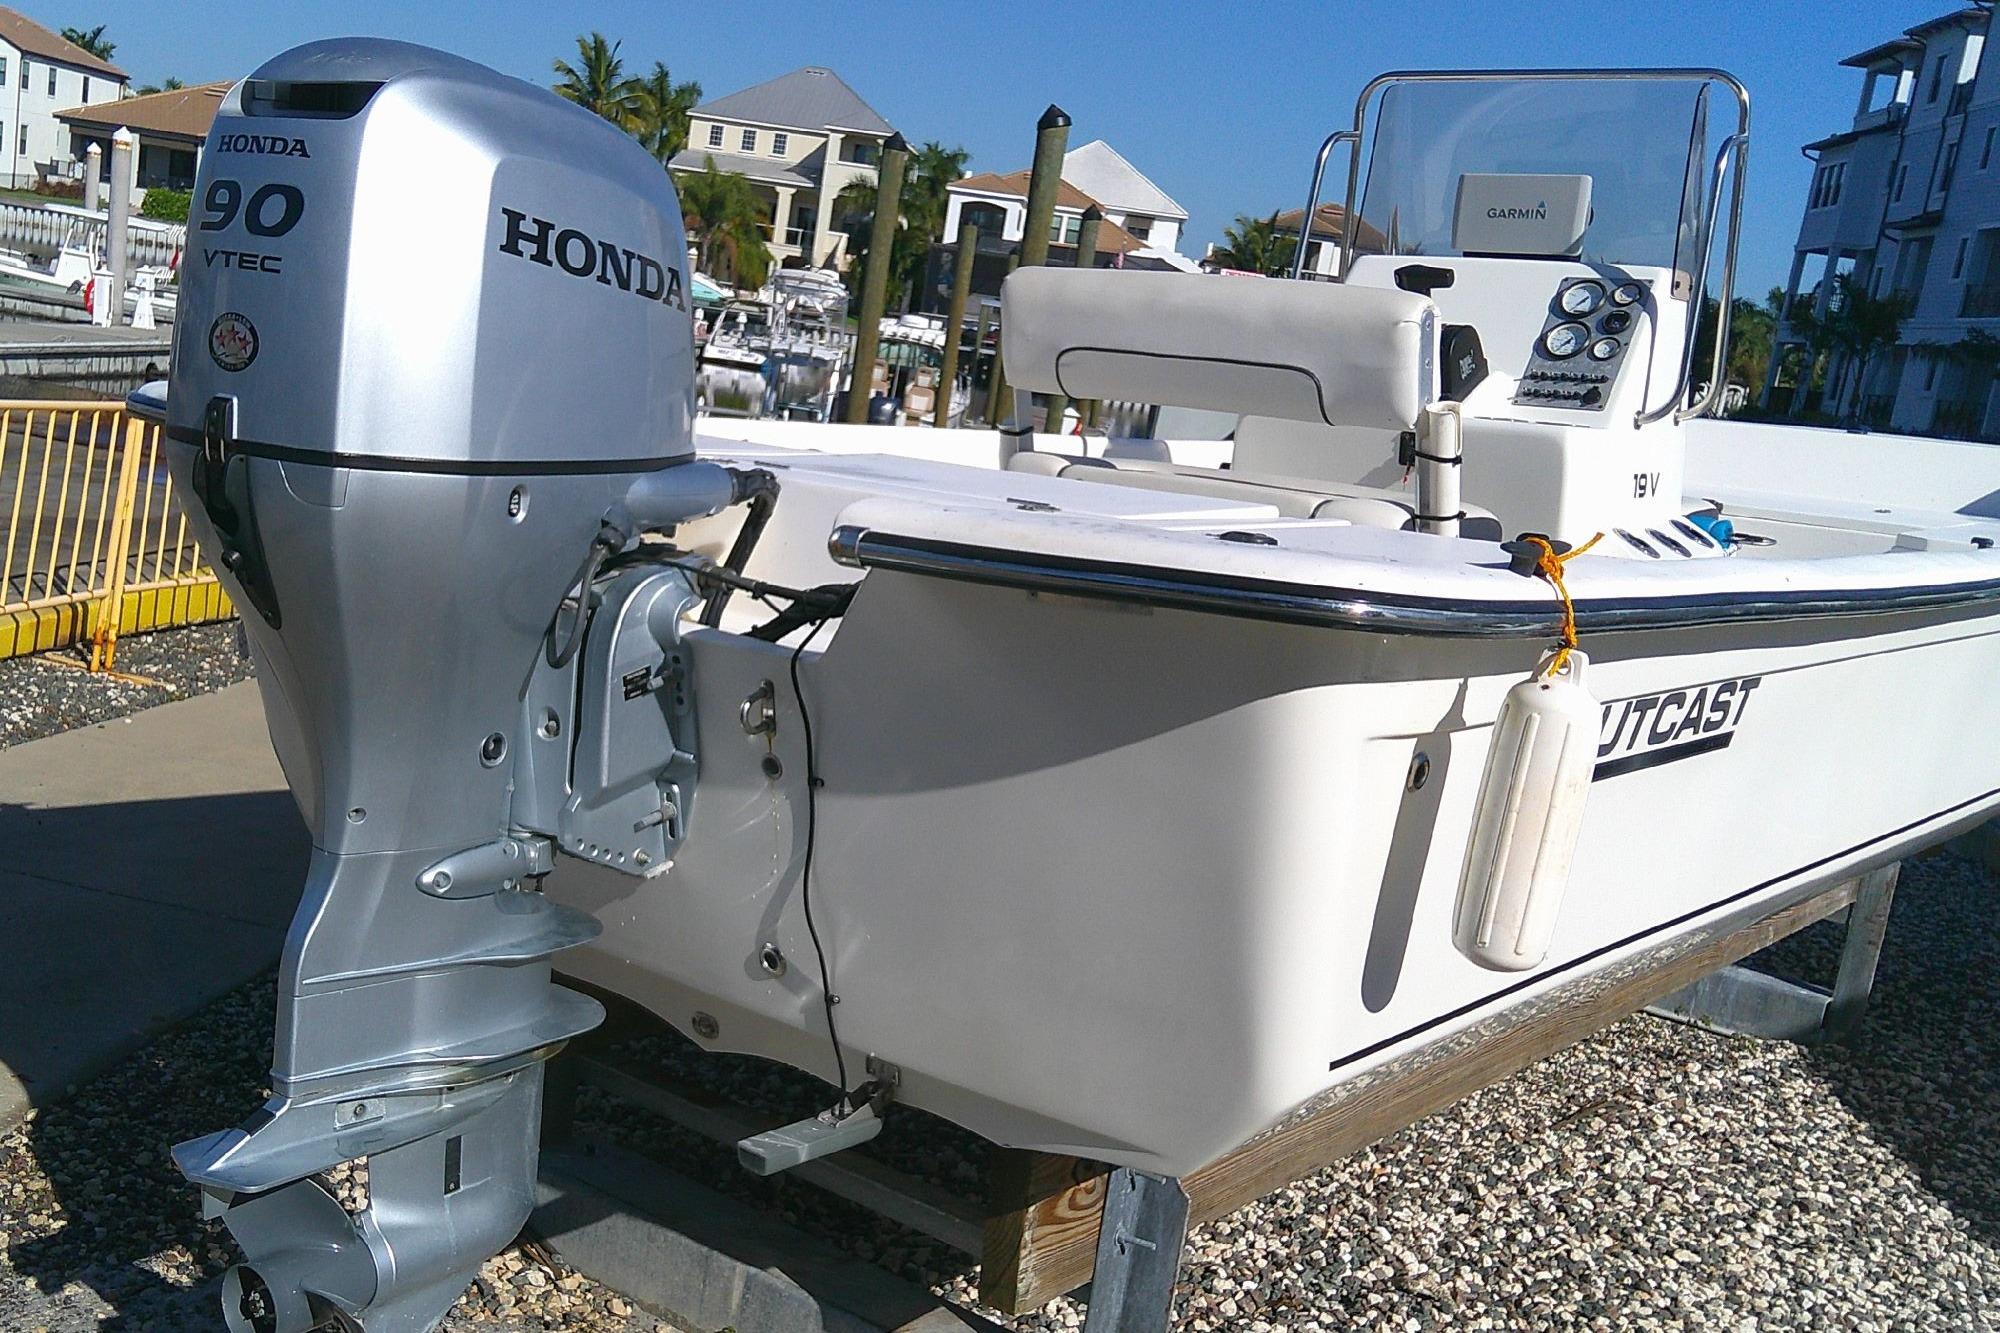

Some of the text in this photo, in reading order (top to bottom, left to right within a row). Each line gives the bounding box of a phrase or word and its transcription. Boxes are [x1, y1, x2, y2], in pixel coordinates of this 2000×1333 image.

[217, 134, 311, 158] HONDA
[200, 179, 305, 238] 90
[1487, 207, 1547, 220] GARMIN
[204, 248, 282, 274] VTEC
[500, 206, 686, 313] HONDA
[1597, 676, 1762, 758] UTCAST
